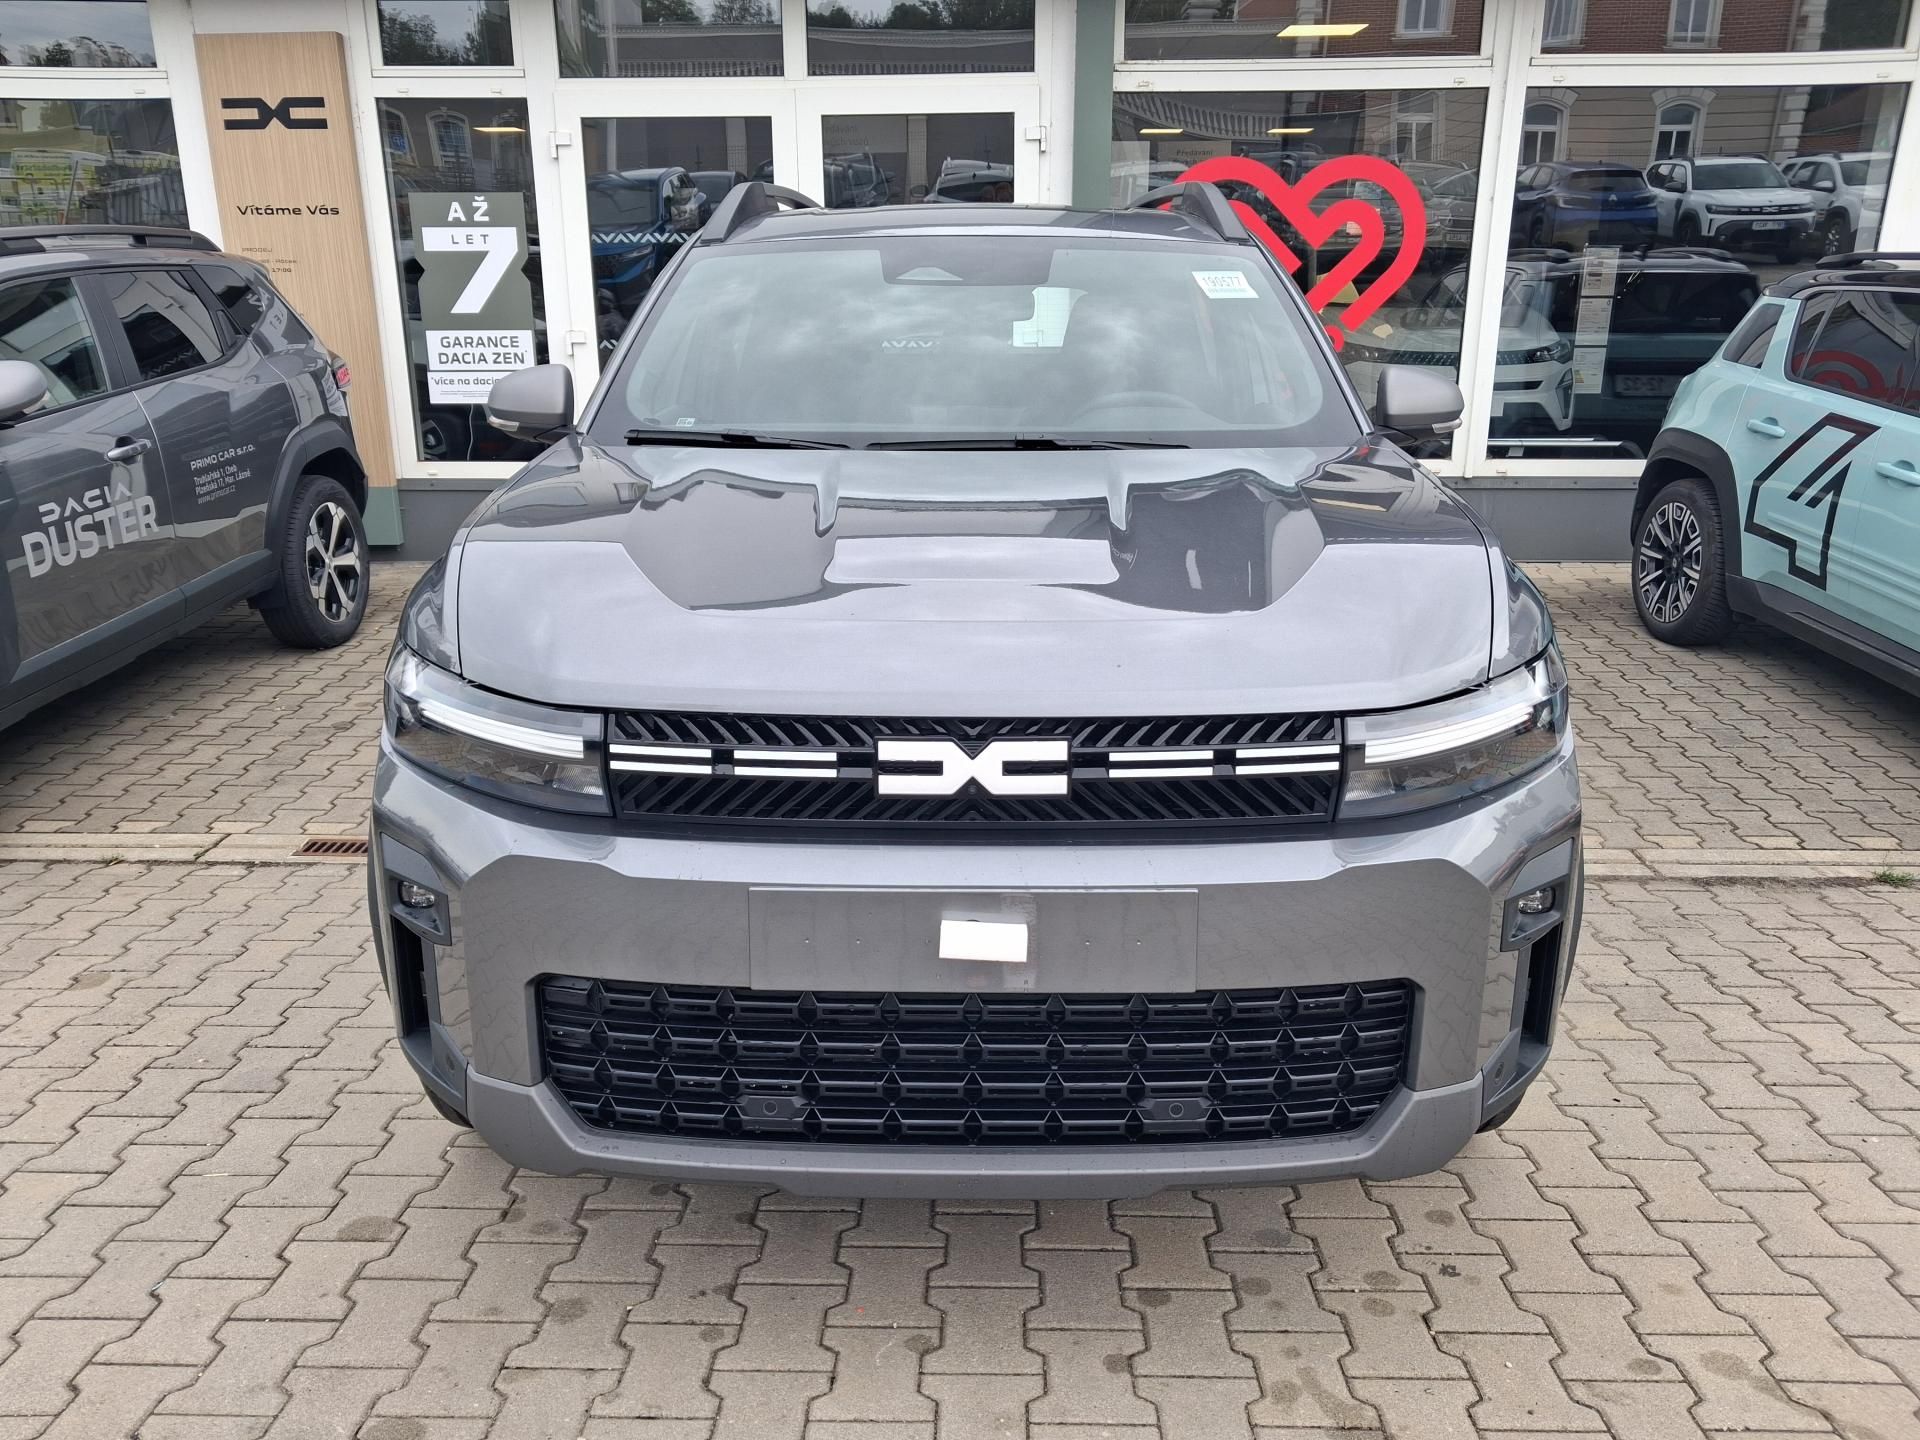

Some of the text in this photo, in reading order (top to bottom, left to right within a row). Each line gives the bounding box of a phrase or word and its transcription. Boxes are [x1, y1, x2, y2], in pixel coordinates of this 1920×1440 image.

[237, 204, 340, 216] Vítáme Vás
[447, 196, 490, 222] AŽ
[451, 234, 489, 245] LET
[421, 226, 519, 314] 7
[440, 336, 519, 348] GARANCE
[438, 352, 488, 364] DACIA
[190, 444, 256, 471] PRIMO CAR s.r.o.
[38, 482, 132, 524] DACIA
[21, 495, 160, 578] DUSTER
